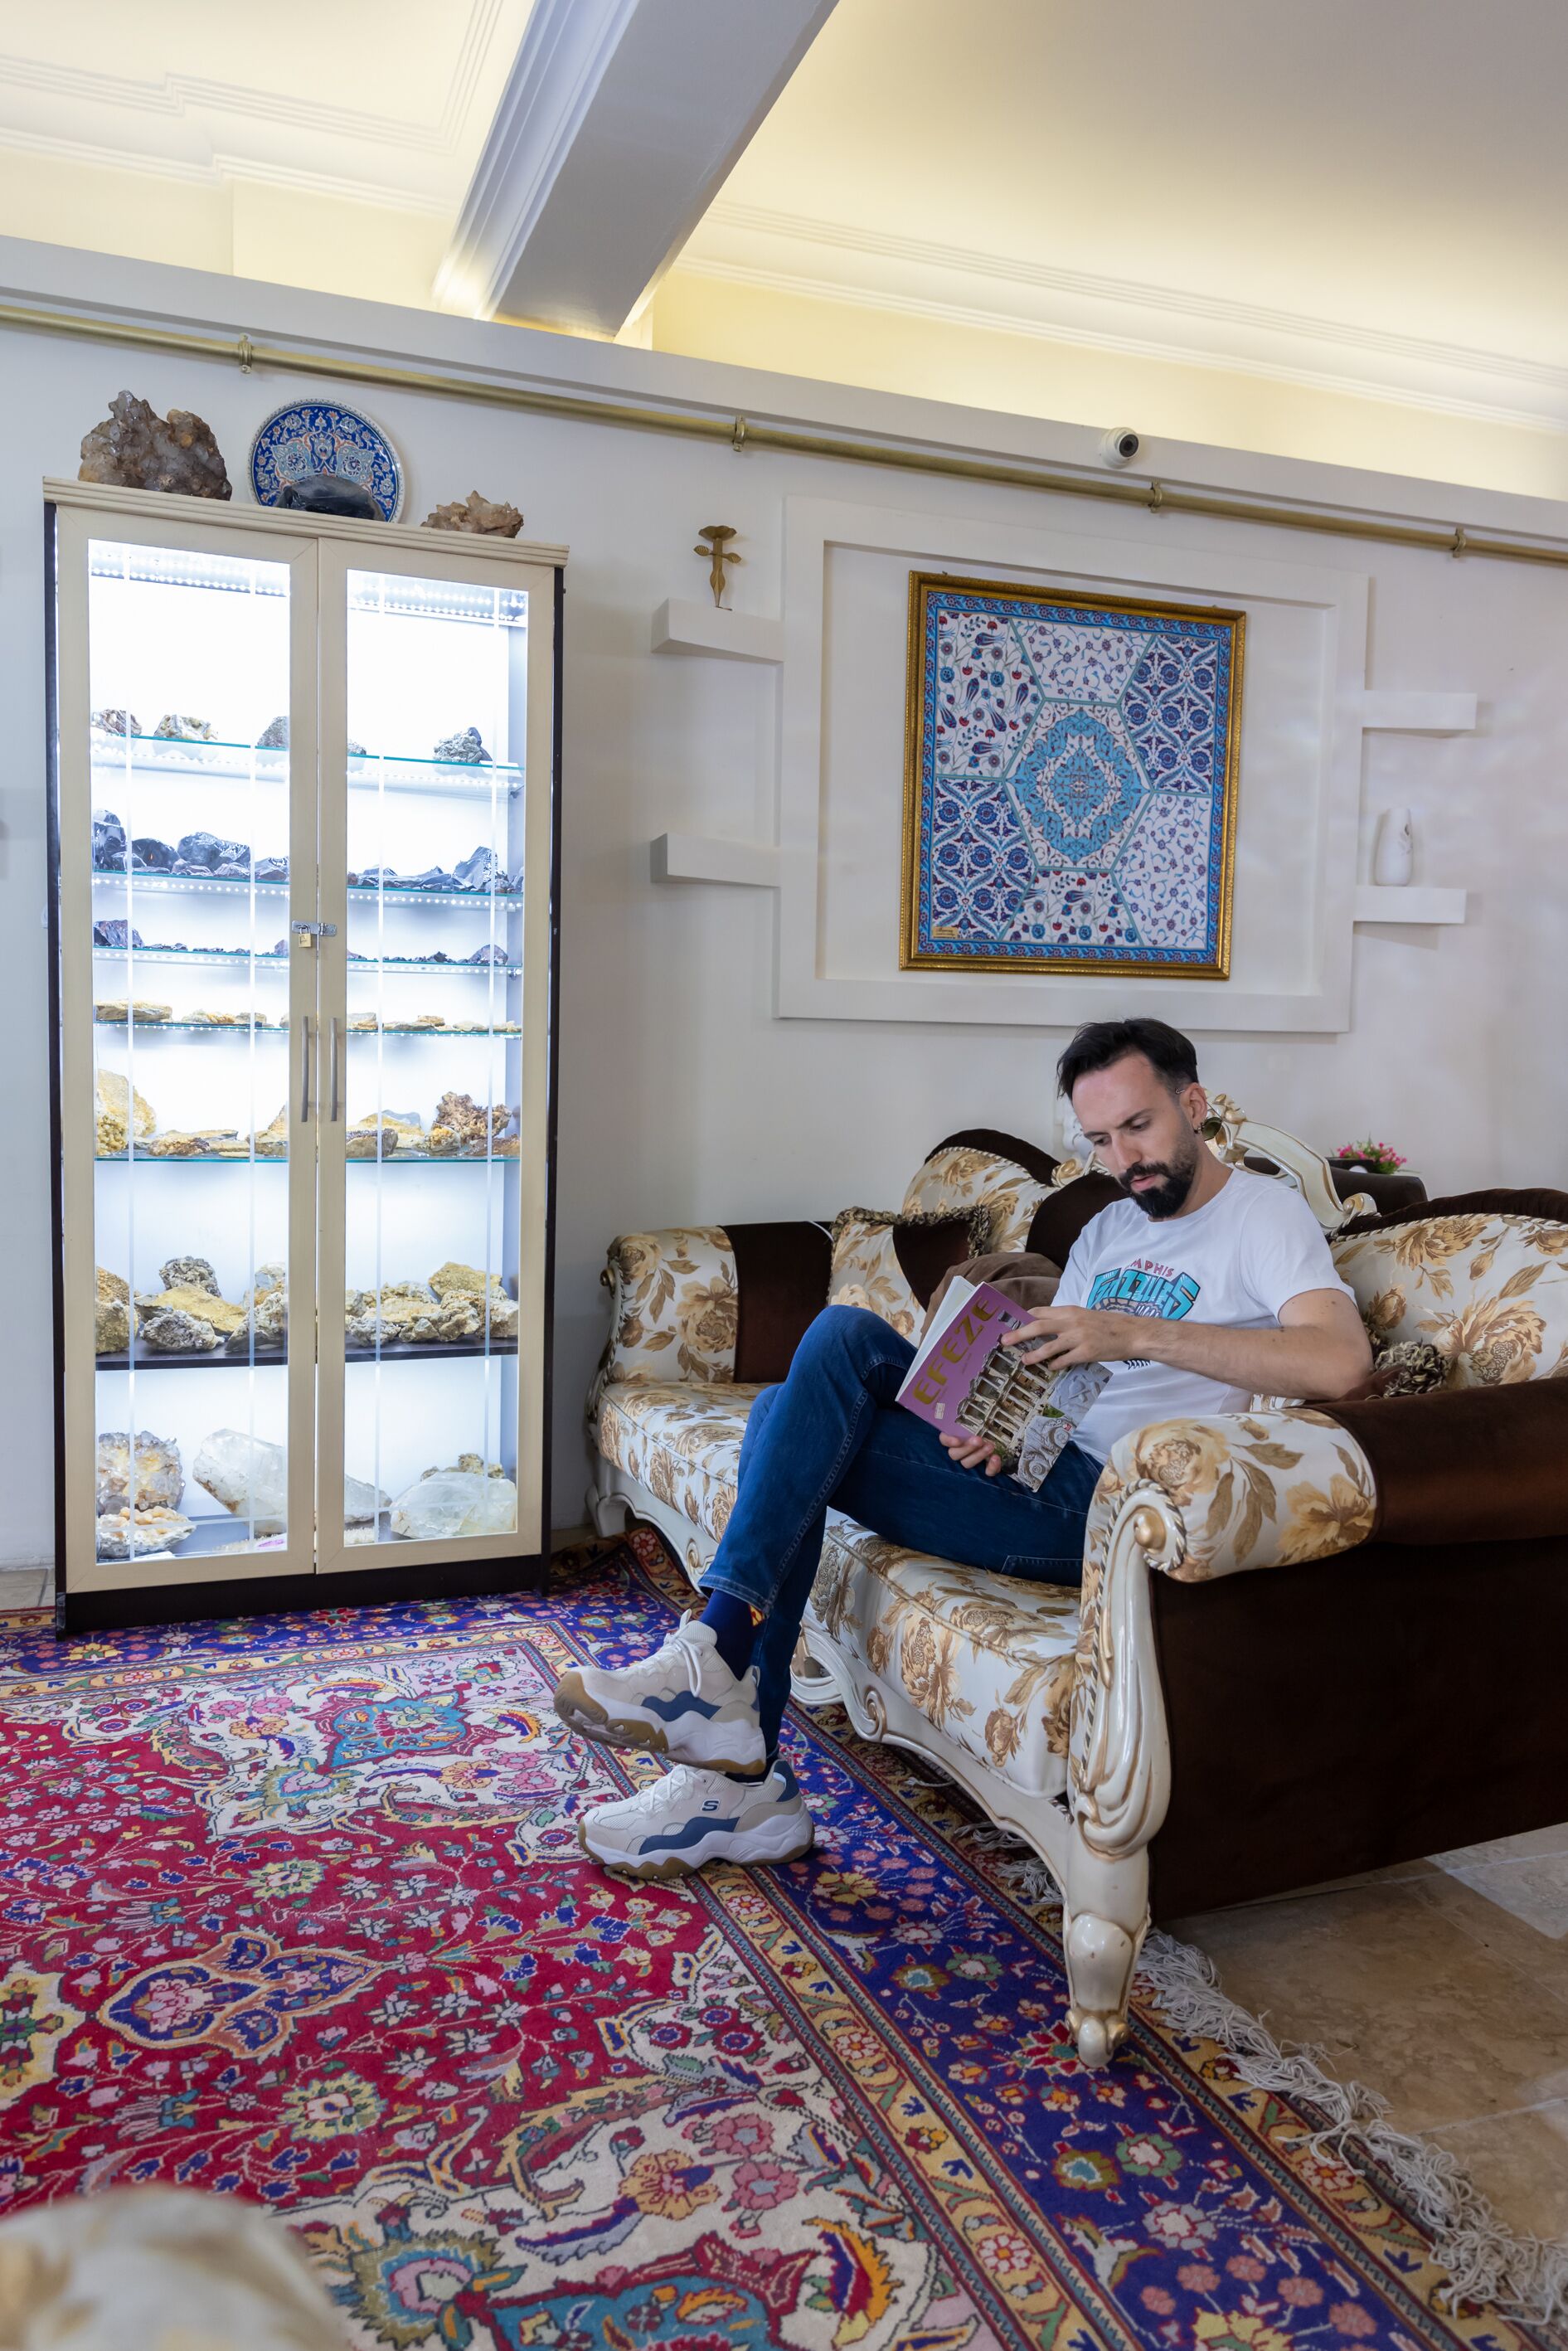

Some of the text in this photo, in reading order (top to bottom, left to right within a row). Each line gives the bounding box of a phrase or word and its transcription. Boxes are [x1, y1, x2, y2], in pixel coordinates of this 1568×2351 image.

[1125, 1258, 1174, 1277] MPHIS
[913, 1295, 999, 1405] EFEZE
[701, 1800, 720, 1811] S
